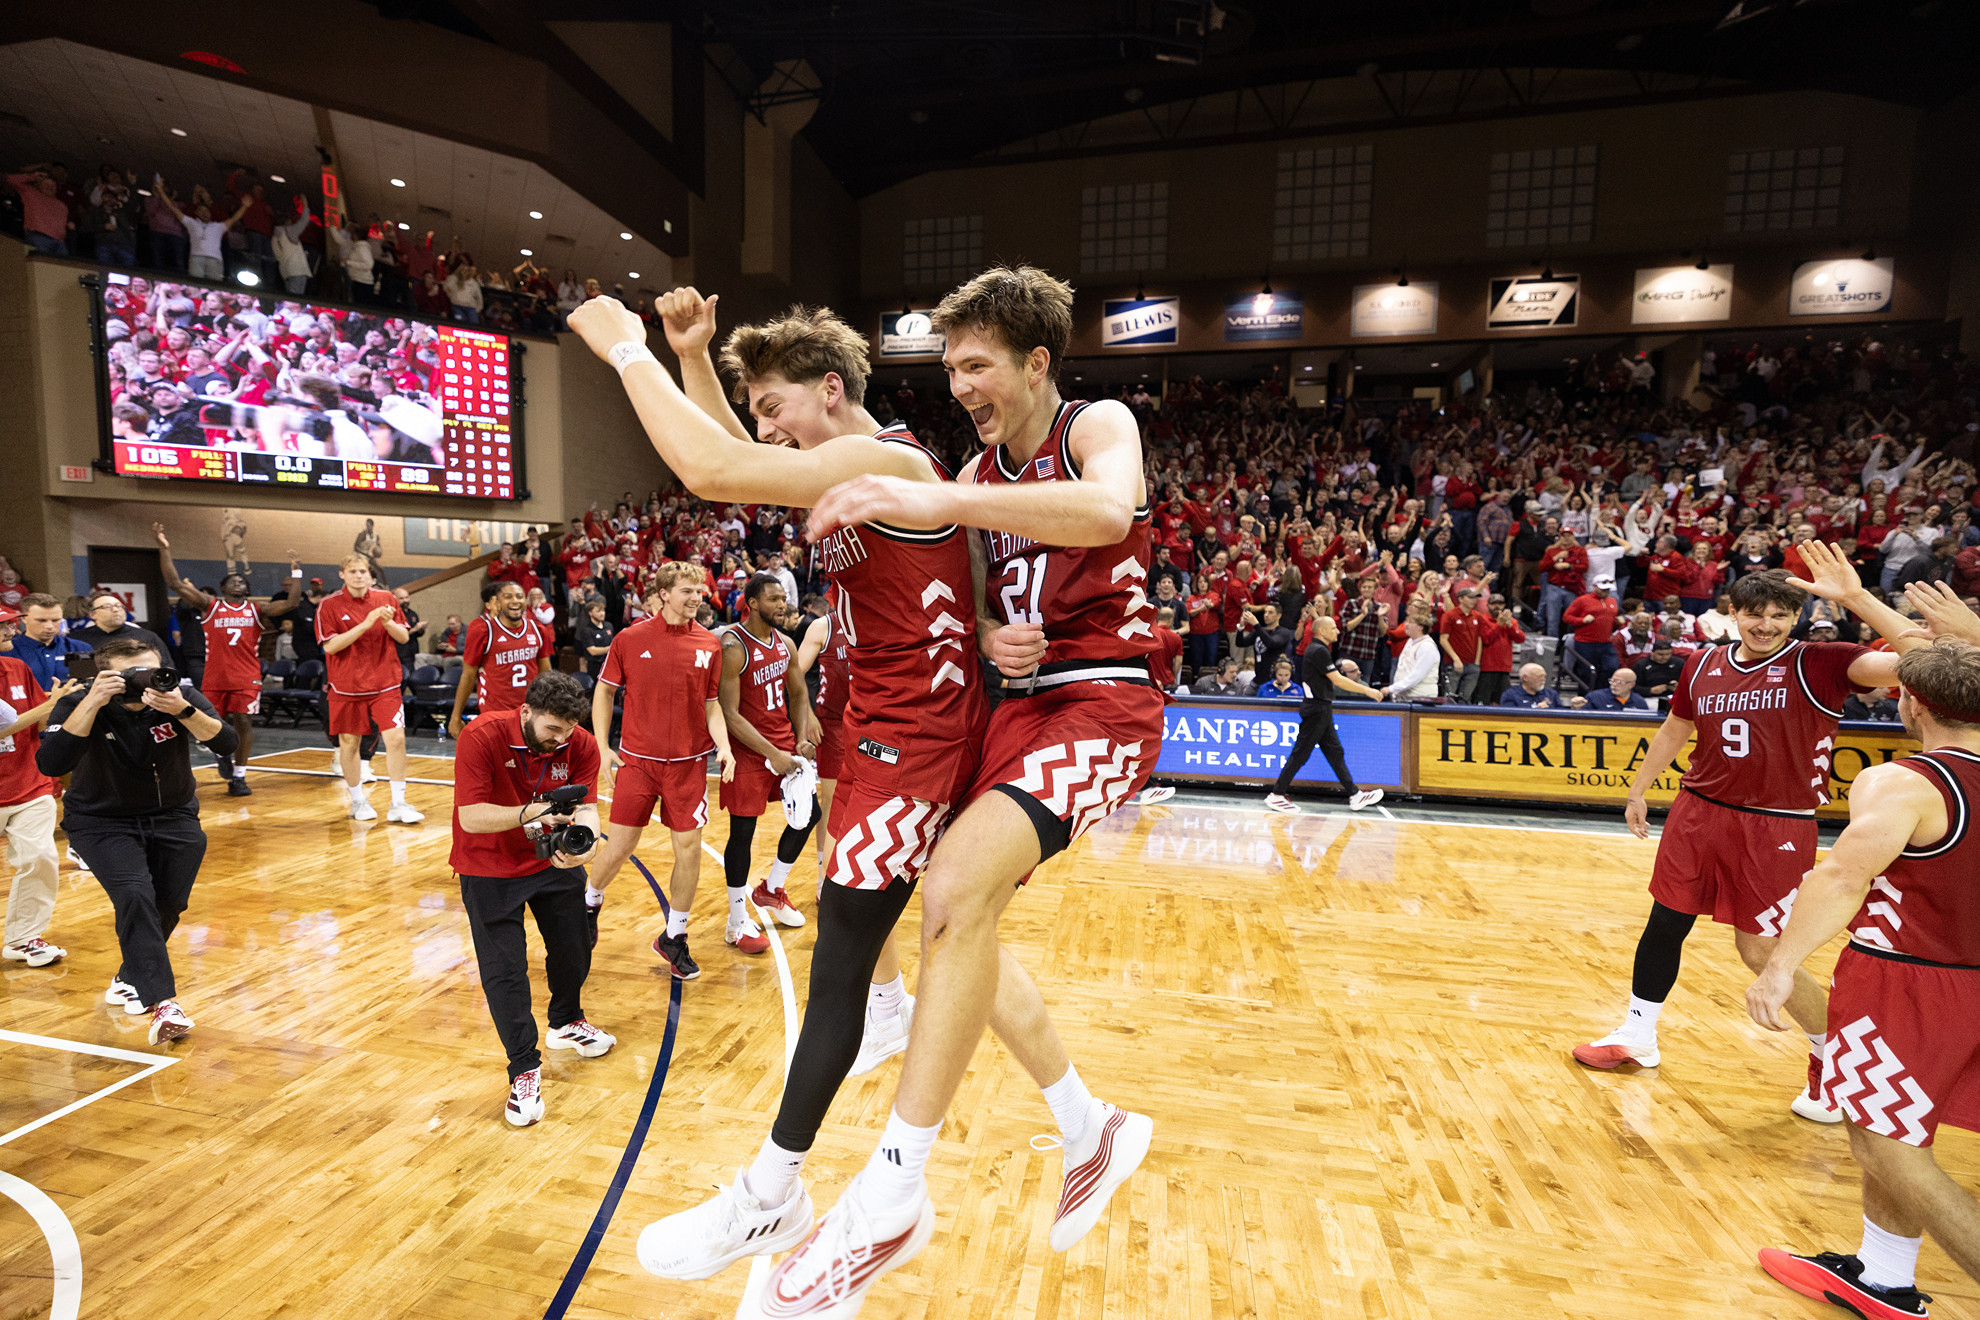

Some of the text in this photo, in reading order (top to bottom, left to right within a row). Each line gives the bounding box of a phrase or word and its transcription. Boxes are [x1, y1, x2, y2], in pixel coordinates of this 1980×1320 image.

[1126, 309, 1172, 332] LEWIS
[1227, 316, 1265, 326] Vern
[126, 446, 178, 466] 105
[274, 455, 312, 472] 0.0
[1000, 552, 1048, 625] 21
[226, 628, 242, 646] 7
[694, 649, 713, 670] N
[512, 663, 527, 688] 2
[10, 685, 27, 700] N
[764, 678, 784, 711] 15
[1697, 687, 1788, 717] NEBRASKA
[149, 722, 178, 743] N
[1721, 717, 1750, 758] 9
[1567, 772, 1633, 789] SIOUX
